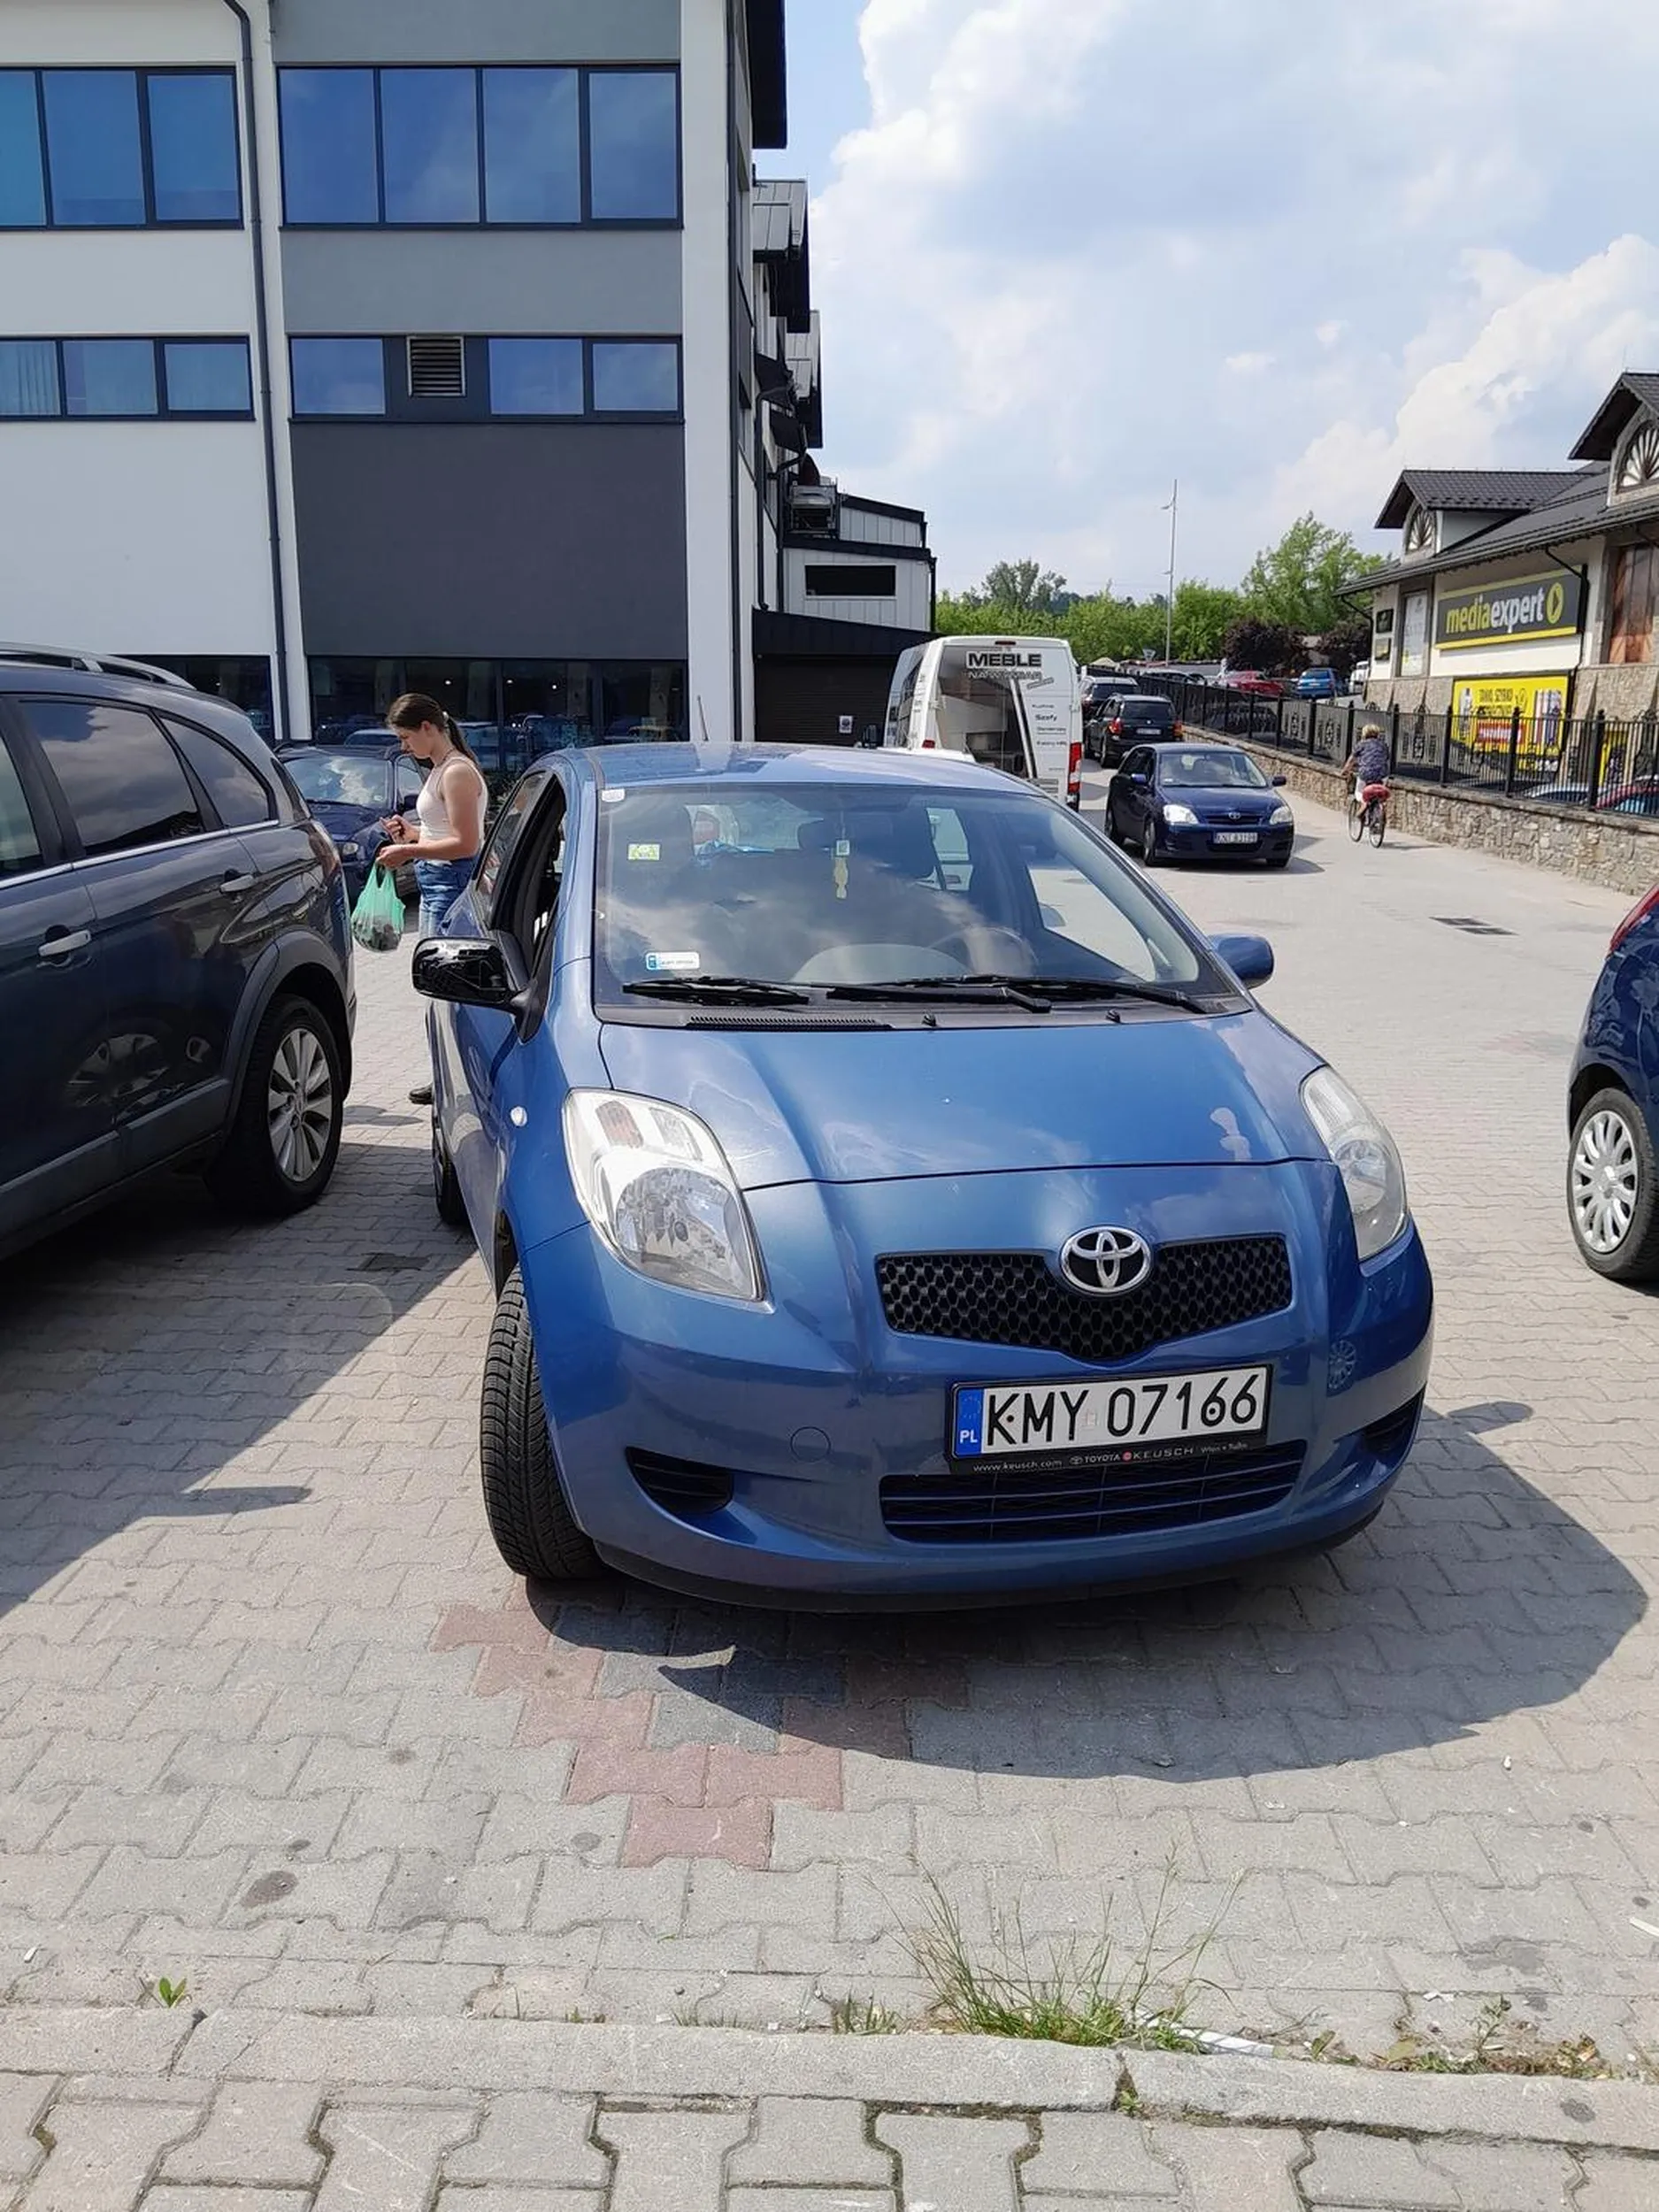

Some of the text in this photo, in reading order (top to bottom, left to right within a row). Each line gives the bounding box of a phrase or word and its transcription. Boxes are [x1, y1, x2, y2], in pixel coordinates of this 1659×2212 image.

[1446, 587, 1545, 634] mediaexpert
[969, 653, 1041, 667] MEBLE
[986, 1373, 1260, 1446] KMY 07166
[959, 1430, 979, 1444] PL
[1084, 1446, 1194, 1464] TOYOTA KEUSCH
